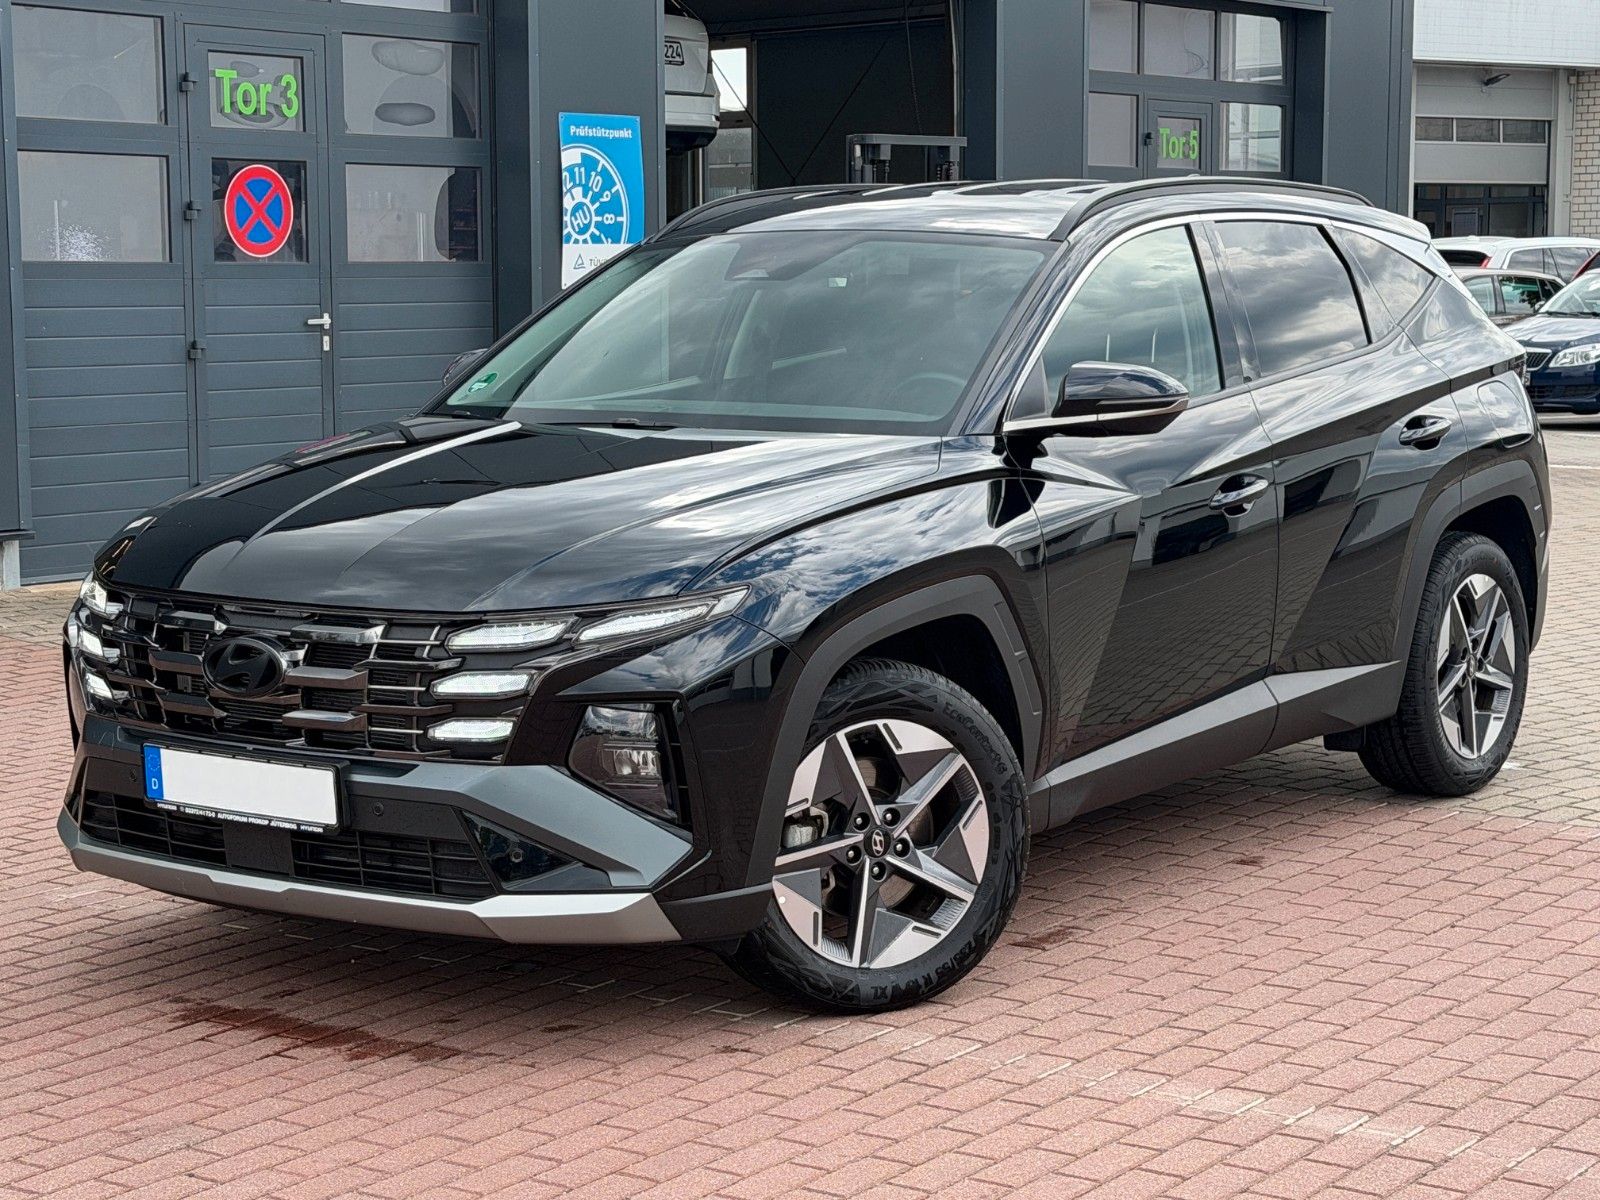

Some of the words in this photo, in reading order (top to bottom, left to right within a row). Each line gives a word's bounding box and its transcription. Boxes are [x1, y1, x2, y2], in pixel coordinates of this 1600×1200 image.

[215, 68, 273, 115] Tor
[281, 74, 299, 118] 3
[570, 125, 632, 139] Prüfstützpunkt
[1159, 127, 1185, 159] Tor
[1189, 129, 1198, 160] 5
[574, 166, 586, 185] 11
[588, 171, 603, 193] 10
[600, 190, 611, 202] 9
[571, 204, 591, 232] HU
[603, 213, 616, 225] 8
[151, 777, 159, 790] D
